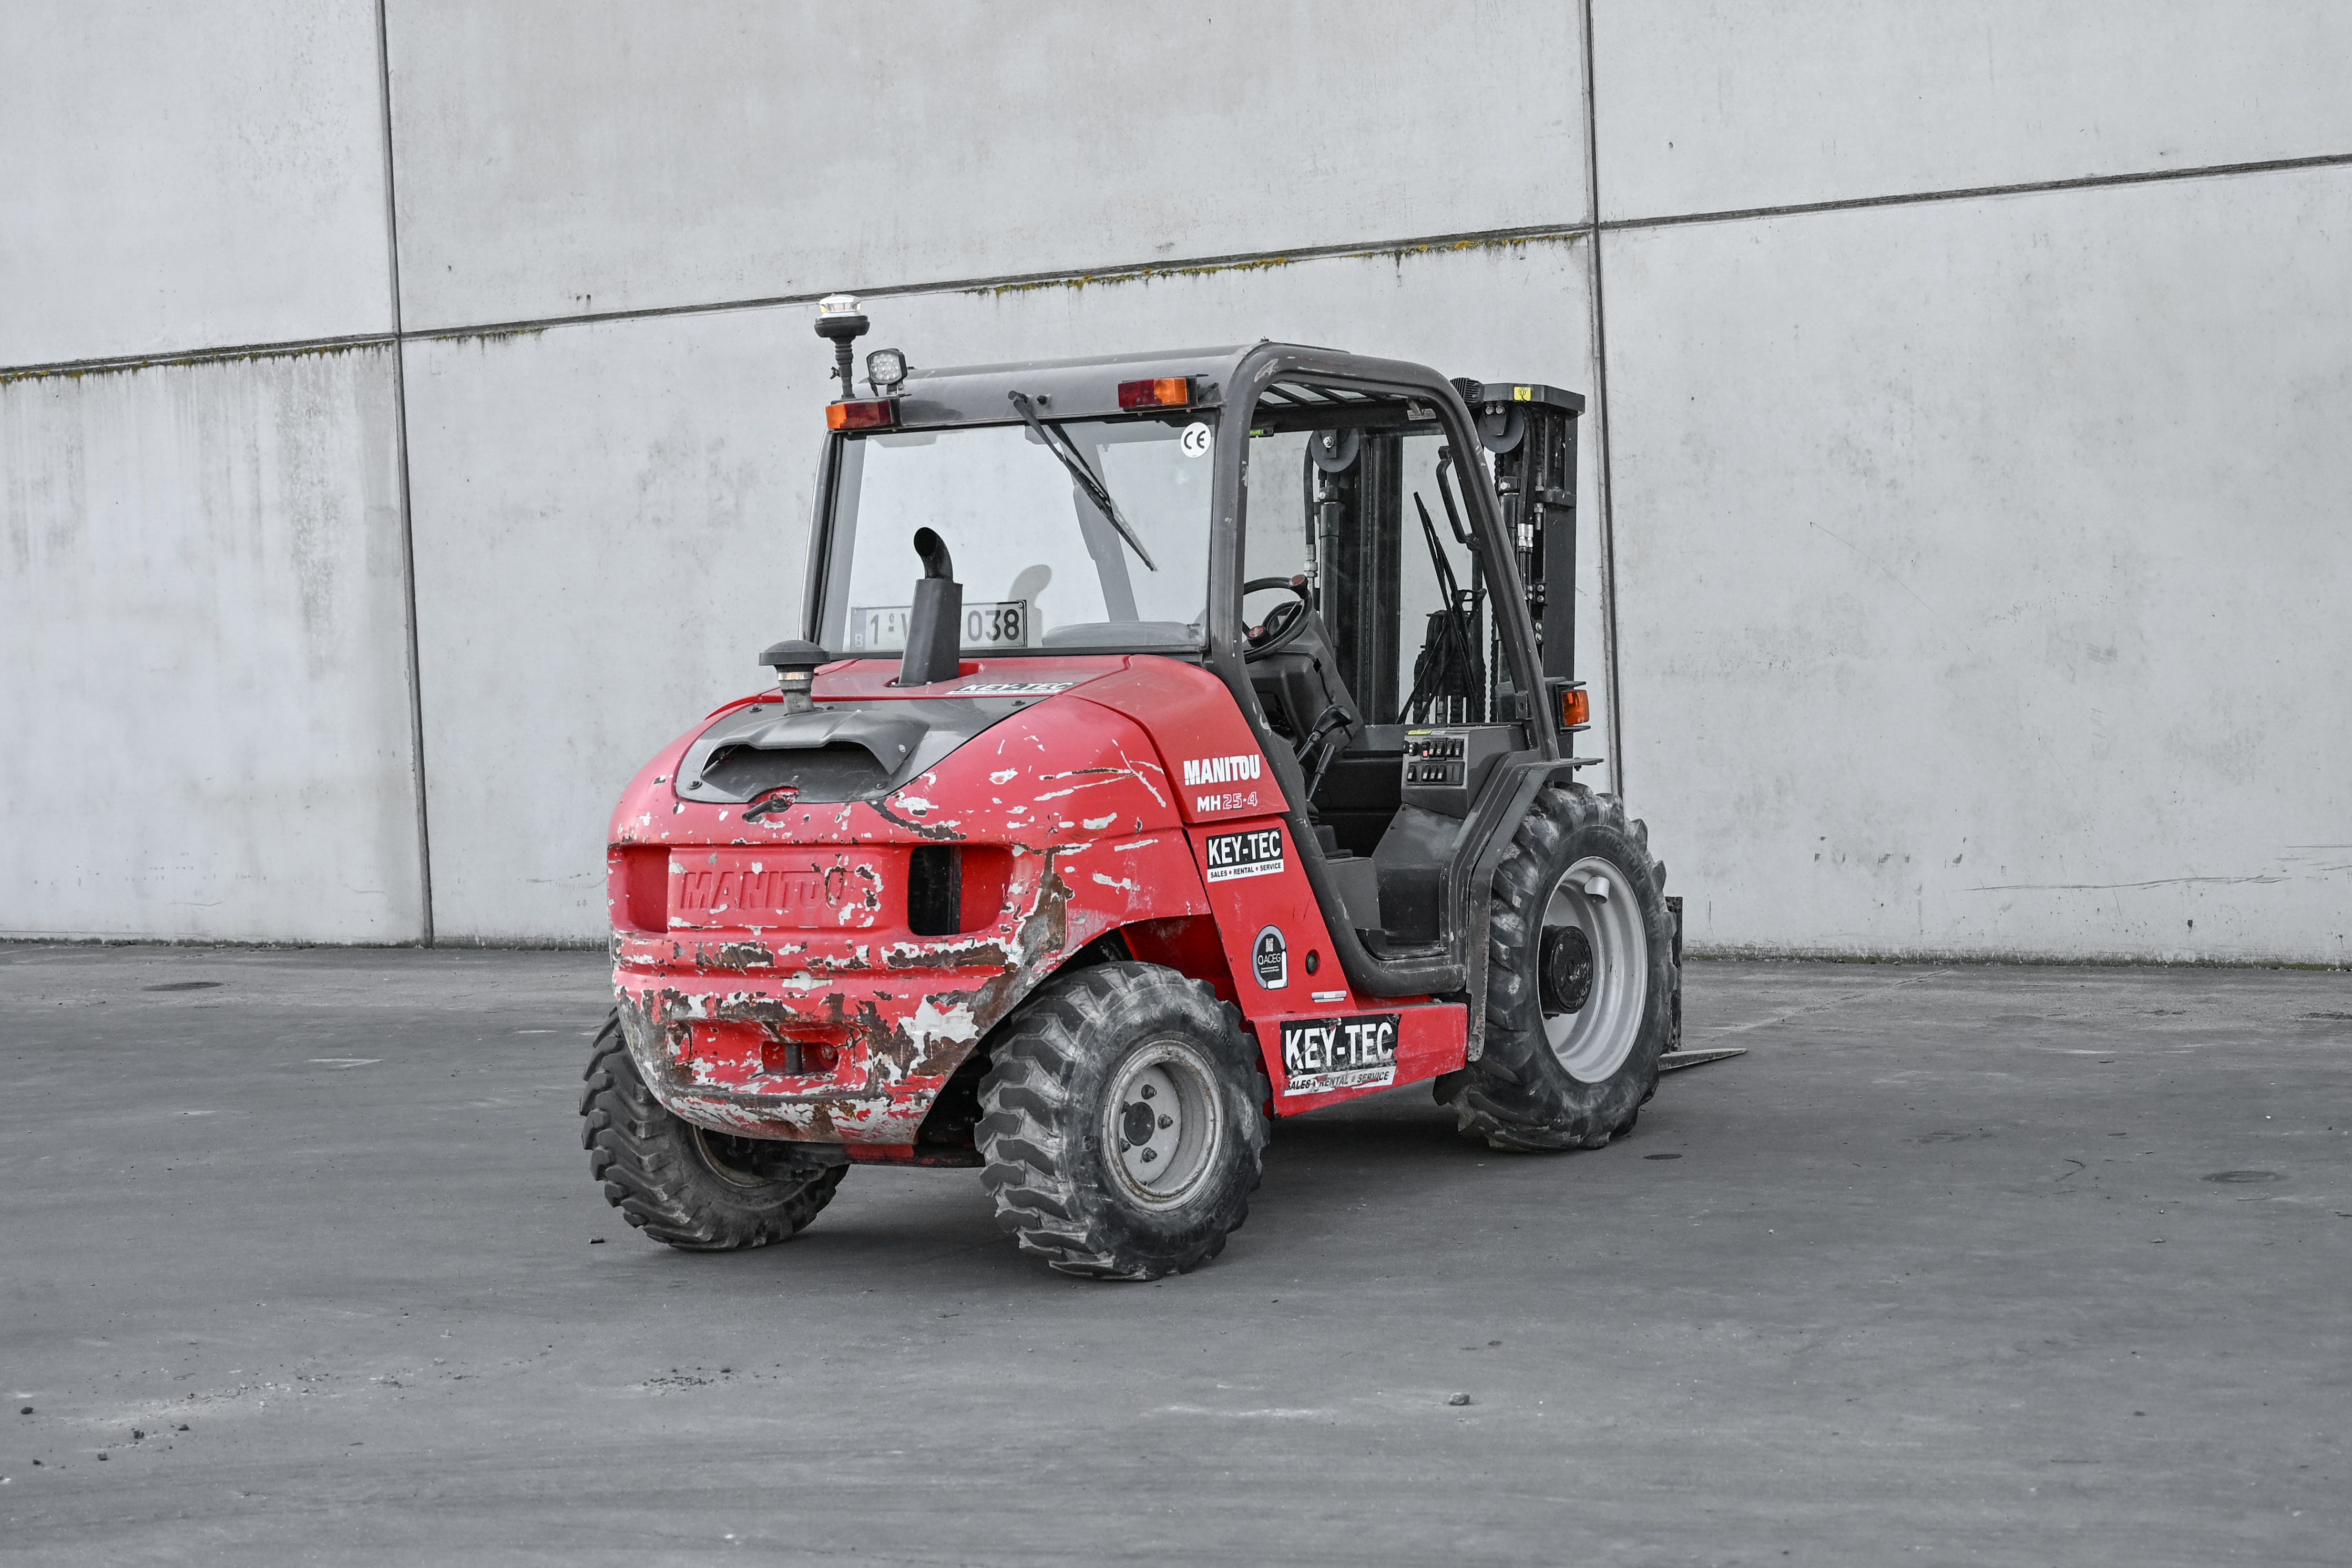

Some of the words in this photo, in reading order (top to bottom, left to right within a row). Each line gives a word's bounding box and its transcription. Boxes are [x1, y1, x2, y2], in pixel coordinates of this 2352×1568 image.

[1183, 430, 1206, 450] CE
[855, 633, 863, 648] B
[959, 682, 1073, 691] KEY-TEC
[1183, 754, 1261, 786] MANITOU
[1208, 831, 1281, 866] KEY-TEC
[1210, 870, 1228, 878] SALES
[1233, 866, 1254, 875] RENTAL
[1260, 863, 1282, 872] SERVICE
[680, 870, 854, 910] MANITOU
[1285, 1022, 1393, 1070] KEY-TEC
